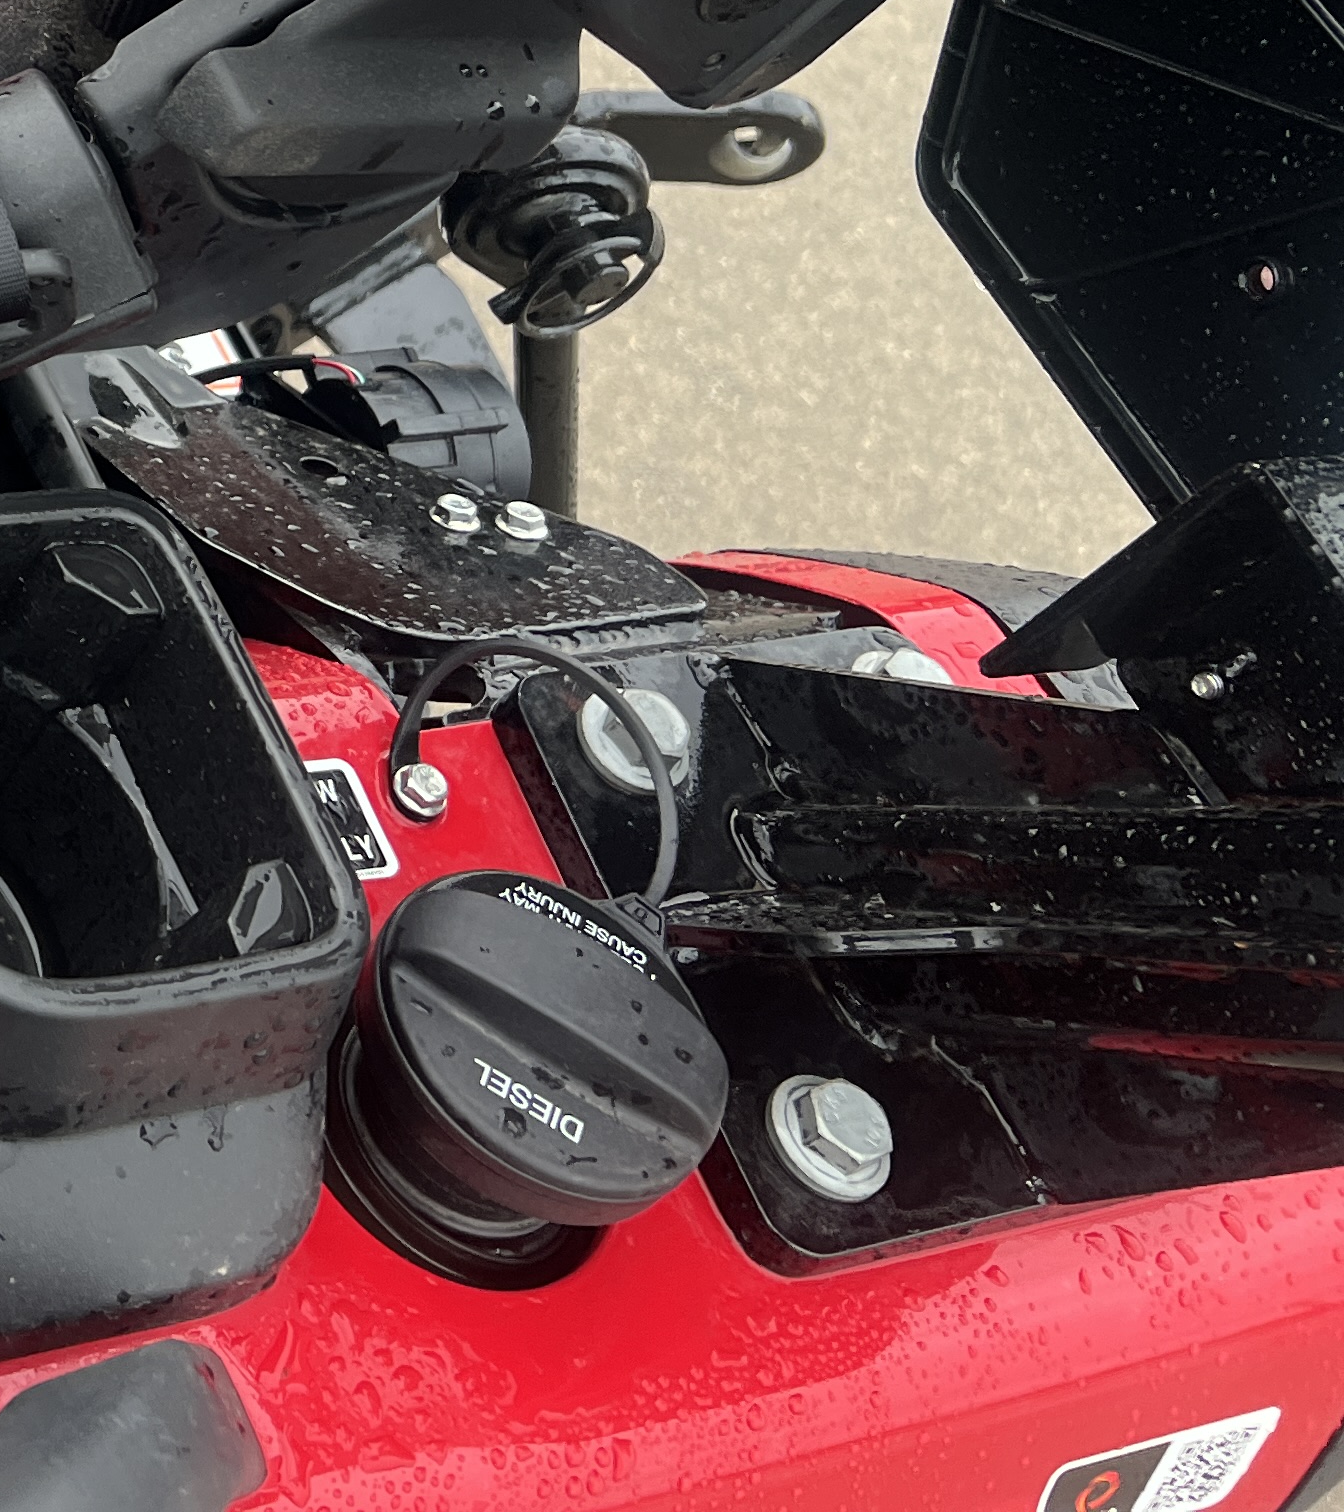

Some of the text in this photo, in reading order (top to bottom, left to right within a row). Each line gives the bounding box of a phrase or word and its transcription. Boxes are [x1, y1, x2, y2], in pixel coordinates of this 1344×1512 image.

[514, 881, 582, 927] INJURY
[583, 919, 648, 965] CAUSE
[474, 1057, 584, 1144] DIESEL
